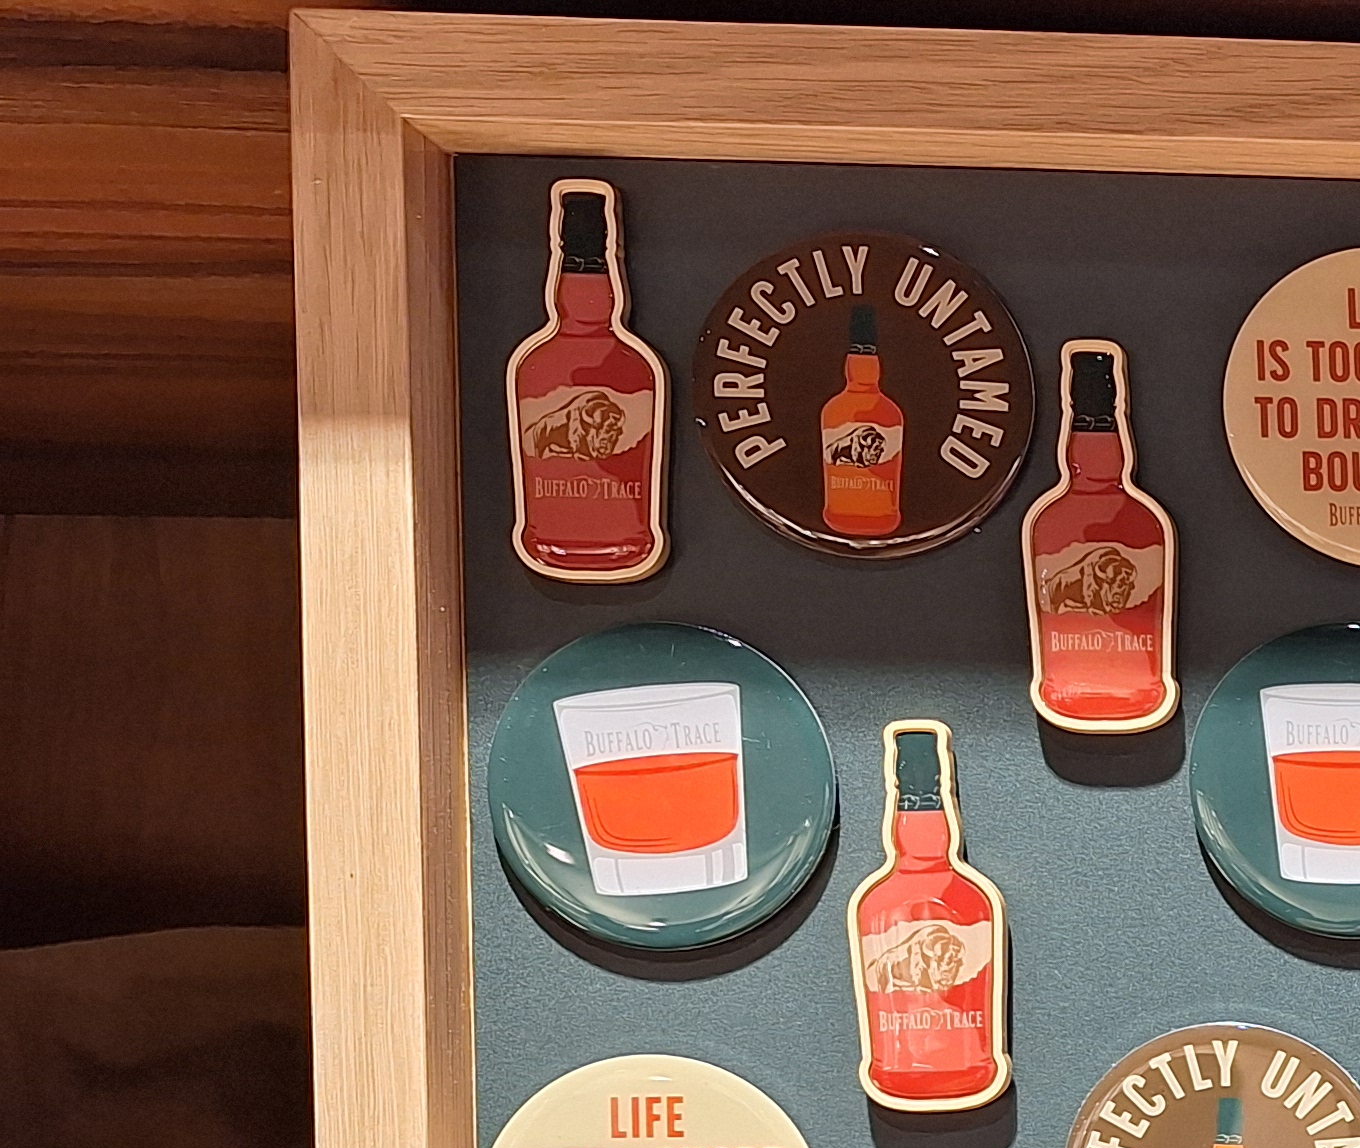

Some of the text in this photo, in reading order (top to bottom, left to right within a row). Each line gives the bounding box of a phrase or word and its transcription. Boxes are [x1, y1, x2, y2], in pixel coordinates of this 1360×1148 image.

[714, 245, 1009, 479] PERFECTLY UNTAMED
[1256, 339, 1290, 381] IS
[1254, 397, 1299, 438] TO
[535, 477, 641, 499] BUFFALO TRACE
[1051, 630, 1153, 652] BUFFALO TRACE
[585, 722, 721, 757] BUFFALO TRACE
[1285, 720, 1349, 746] BUFFALO
[879, 1009, 983, 1031] BUFFALO TRACE
[610, 1096, 684, 1138] LIFE
